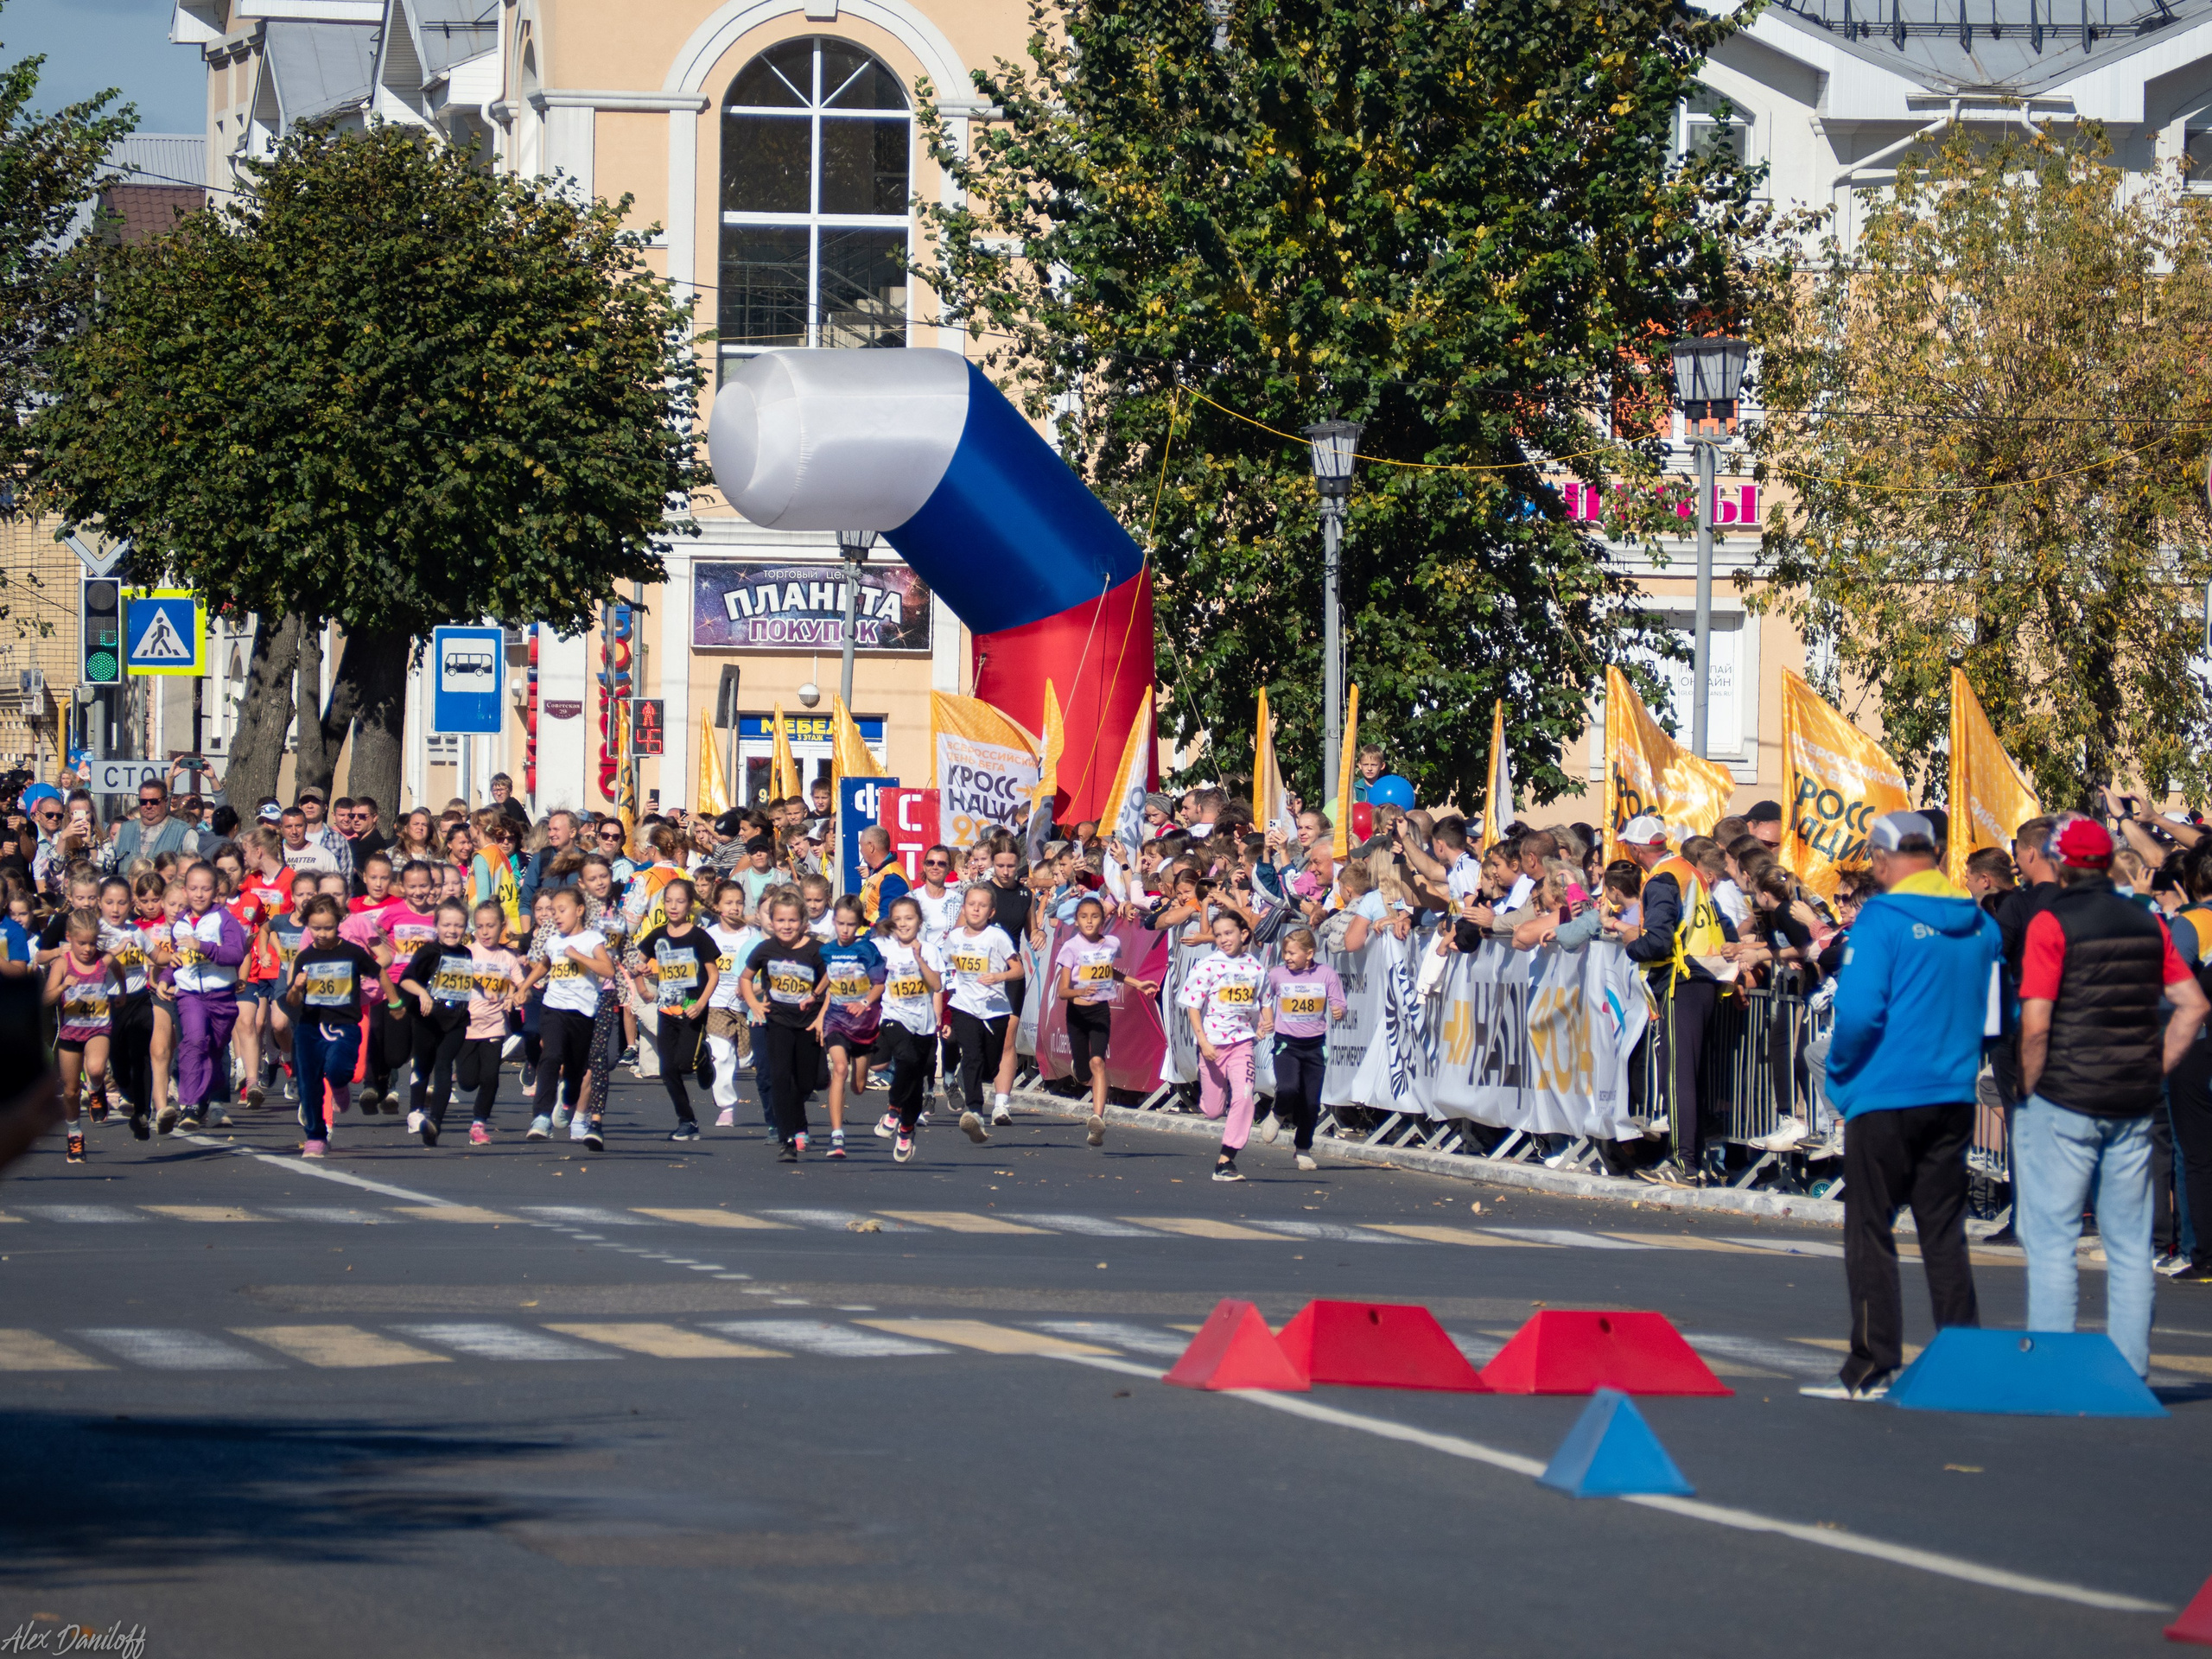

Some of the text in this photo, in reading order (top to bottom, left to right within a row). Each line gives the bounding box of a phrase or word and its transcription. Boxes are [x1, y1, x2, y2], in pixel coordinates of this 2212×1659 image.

[763, 569, 817, 580] торговый
[1680, 663, 1732, 674] ППАЙ
[1680, 676, 1732, 687] ОНАЙН
[546, 701, 581, 710] Советская
[946, 741, 1039, 770] ВСЕРОССИЙСКИ
[978, 760, 1006, 772] БЕГА
[948, 788, 1020, 827] НАЦИ
[1790, 800, 1872, 863] АЦИ
[285, 856, 316, 865] MATTER
[551, 962, 579, 979] 2590
[957, 957, 982, 971] 1755
[1090, 964, 1110, 979] 220
[662, 964, 688, 980] 1532
[318, 979, 334, 995] 36
[442, 974, 471, 989] 2515
[775, 978, 806, 994] 2505
[840, 982, 857, 995] 94
[893, 980, 925, 996] 1522
[79, 1001, 96, 1015] 44
[1291, 998, 1314, 1013] 248
